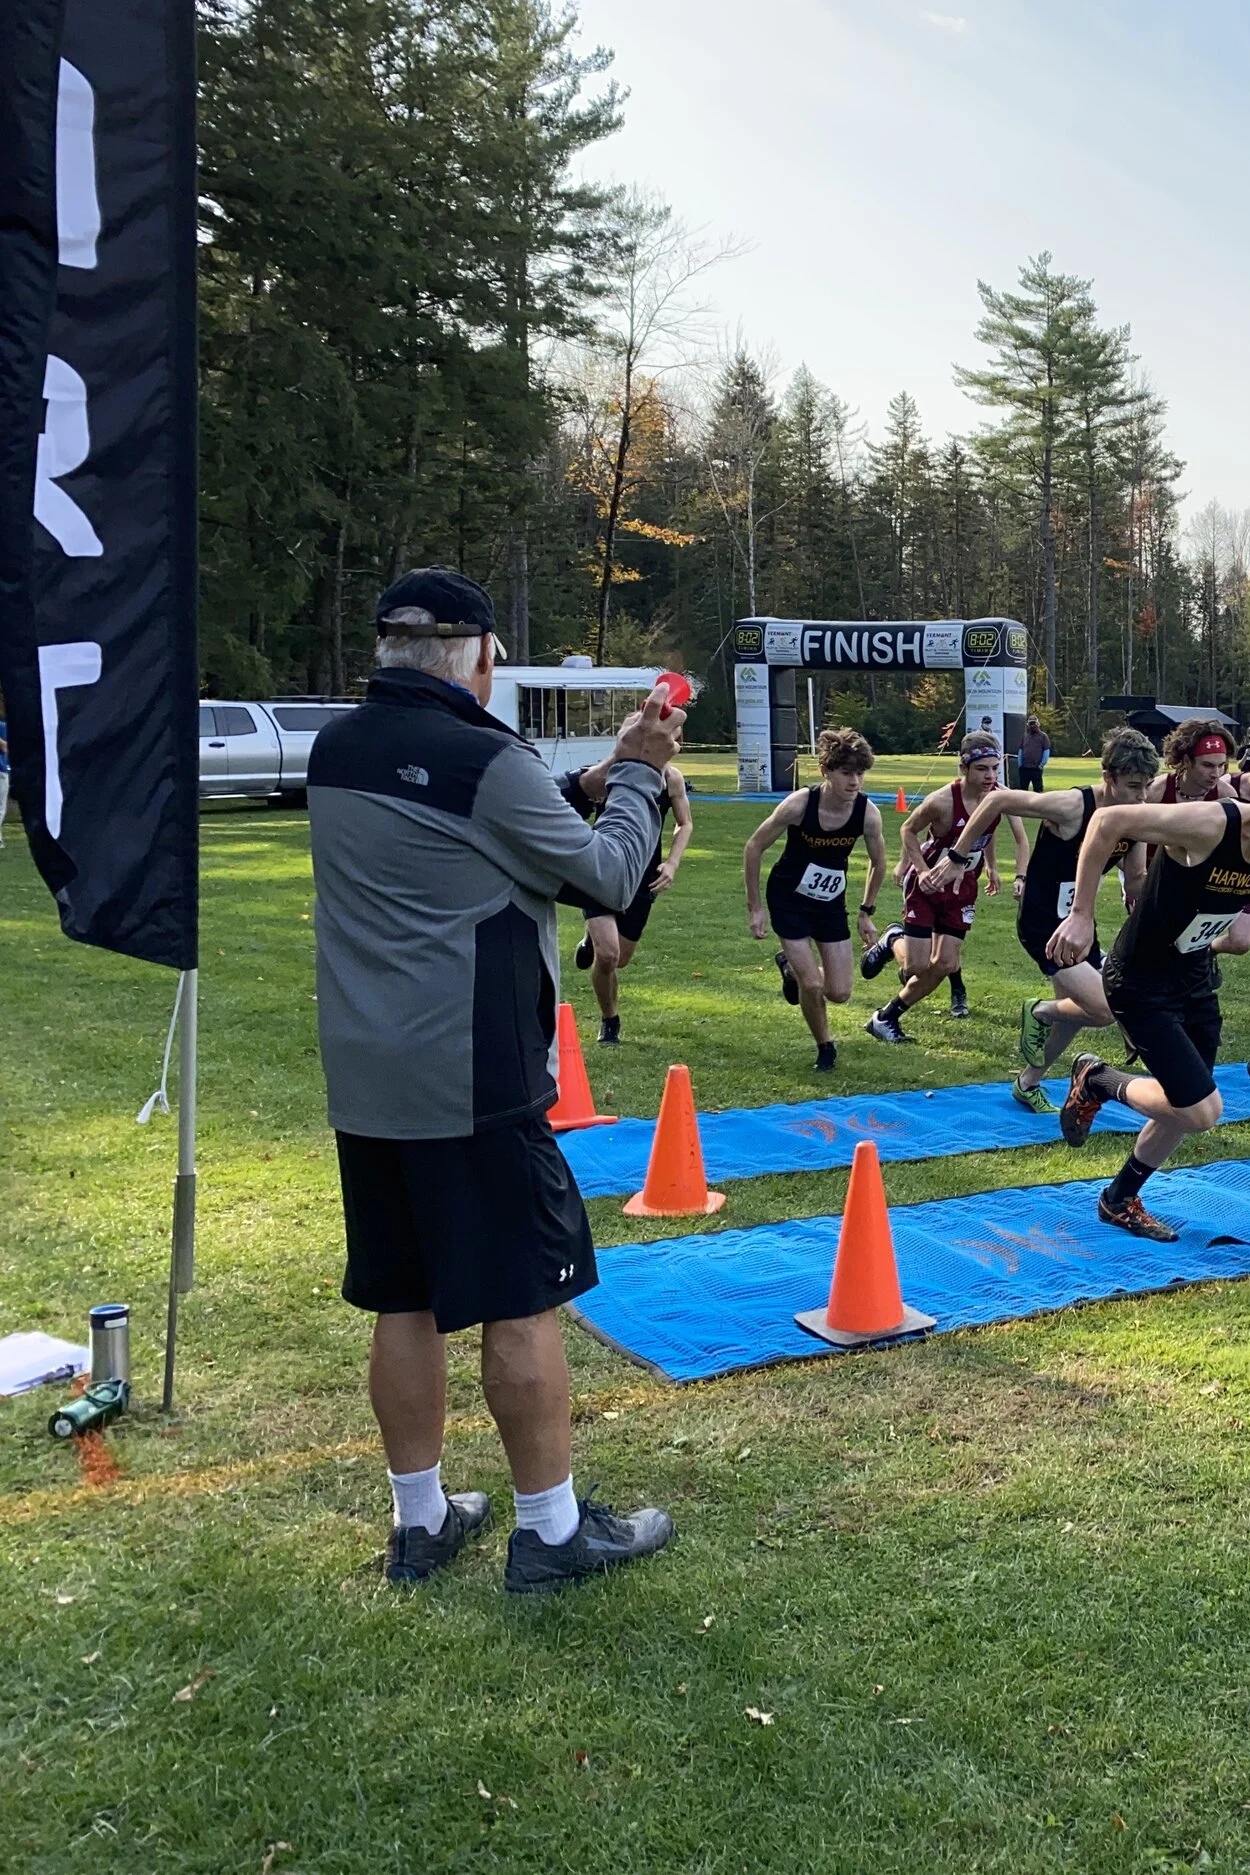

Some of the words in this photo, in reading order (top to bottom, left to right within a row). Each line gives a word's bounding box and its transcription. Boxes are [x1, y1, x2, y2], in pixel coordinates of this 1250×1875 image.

[738, 632, 759, 644] 8:02
[969, 633, 994, 646] 8:02
[803, 630, 921, 664] FINISH
[801, 831, 855, 847] HARWOOD
[808, 872, 842, 894] 348
